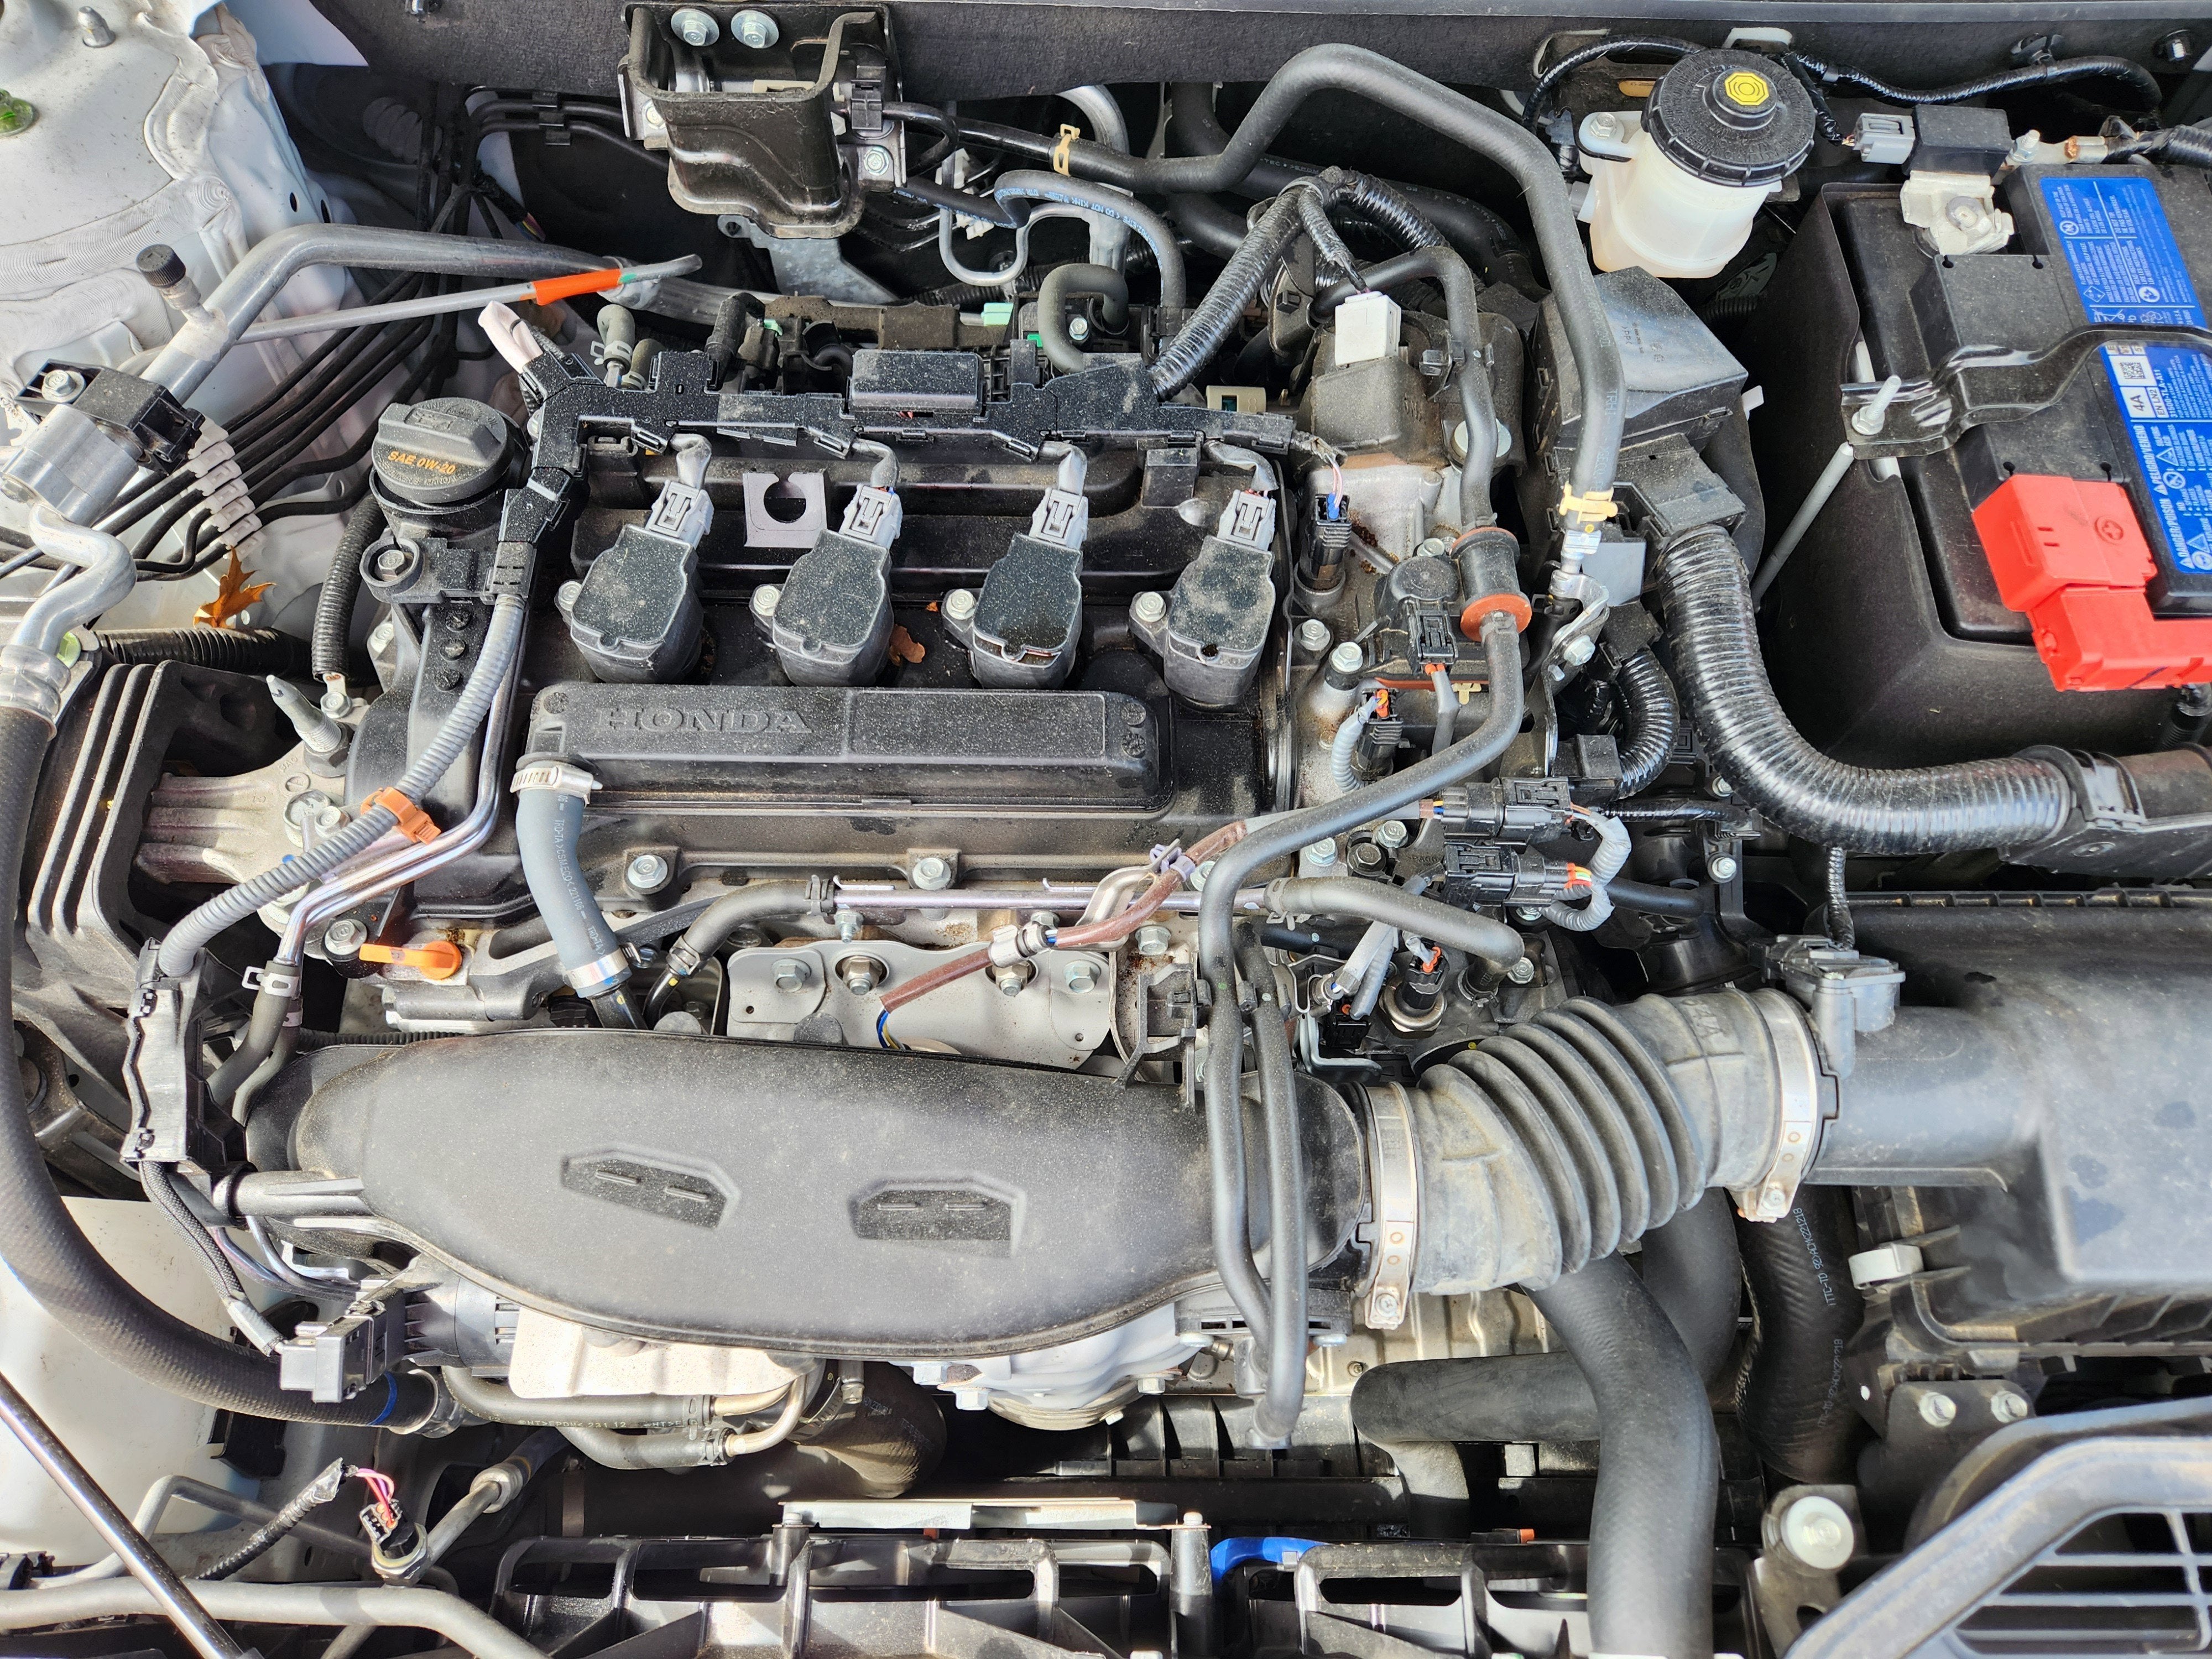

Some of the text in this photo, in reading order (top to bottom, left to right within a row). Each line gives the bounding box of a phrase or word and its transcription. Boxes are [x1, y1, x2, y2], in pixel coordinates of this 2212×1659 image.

[2128, 395, 2146, 410] 4A
[2150, 389, 2165, 415] EN LN2
[388, 450, 457, 475] SAE 0W-20
[2132, 424, 2164, 483] PELIGRO/VENENO
[2157, 498, 2190, 557] DANGER/POISON
[592, 707, 814, 733] HONDA
